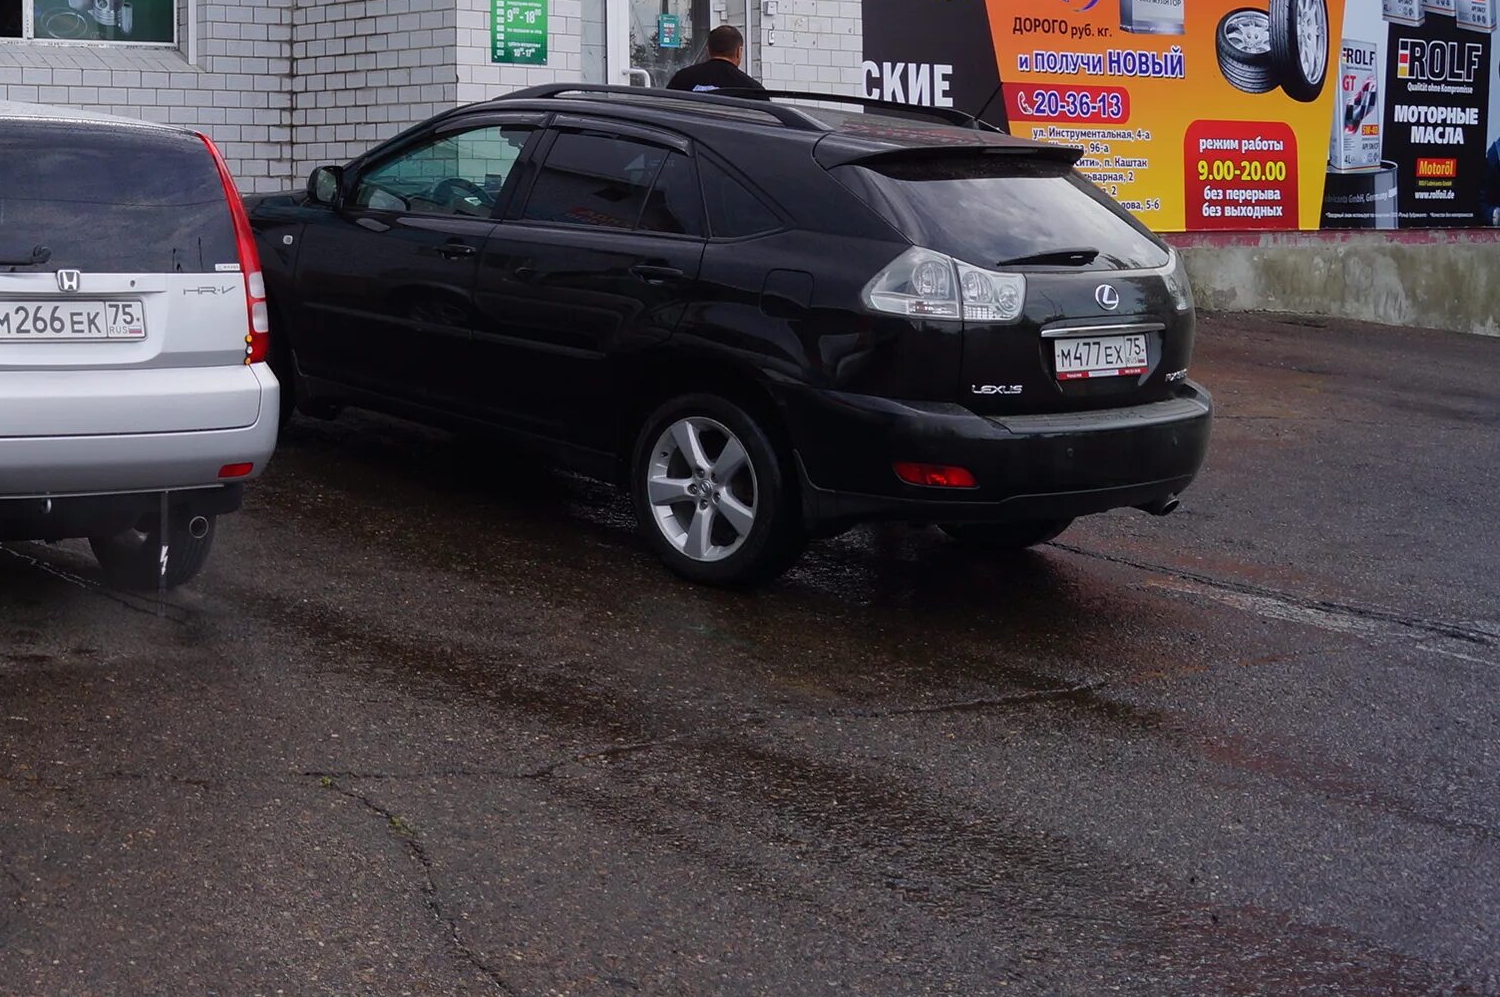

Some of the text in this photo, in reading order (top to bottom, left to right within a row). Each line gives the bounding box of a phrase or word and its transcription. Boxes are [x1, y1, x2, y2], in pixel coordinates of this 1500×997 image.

[1013, 17, 1112, 40] ДОРОГО руб. кг.
[1018, 45, 1186, 79] и ПОЛУЧИ НОВЫЙ
[1346, 47, 1375, 66] ROLF
[1403, 38, 1482, 82] ROLF
[1342, 74, 1356, 91] GT
[1032, 90, 1123, 119] 20-36-13
[1394, 105, 1478, 124] МОТОРНЫЕ
[1032, 128, 1046, 139] ул.
[1049, 128, 1134, 141] Инструментальная,
[1411, 126, 1464, 144] МАСЛА
[1199, 136, 1284, 152] режим работы
[1114, 157, 1148, 169] Каштак
[1197, 160, 1286, 182] 9.00-20.00
[1419, 160, 1453, 175] Motoröl
[1204, 186, 1281, 203] без перерыва
[1202, 202, 1283, 220] без выходных
[108, 304, 133, 325] 75
[109, 325, 129, 335] RUS
[1126, 338, 1141, 356] 75
[971, 384, 1023, 394] LEXUS
